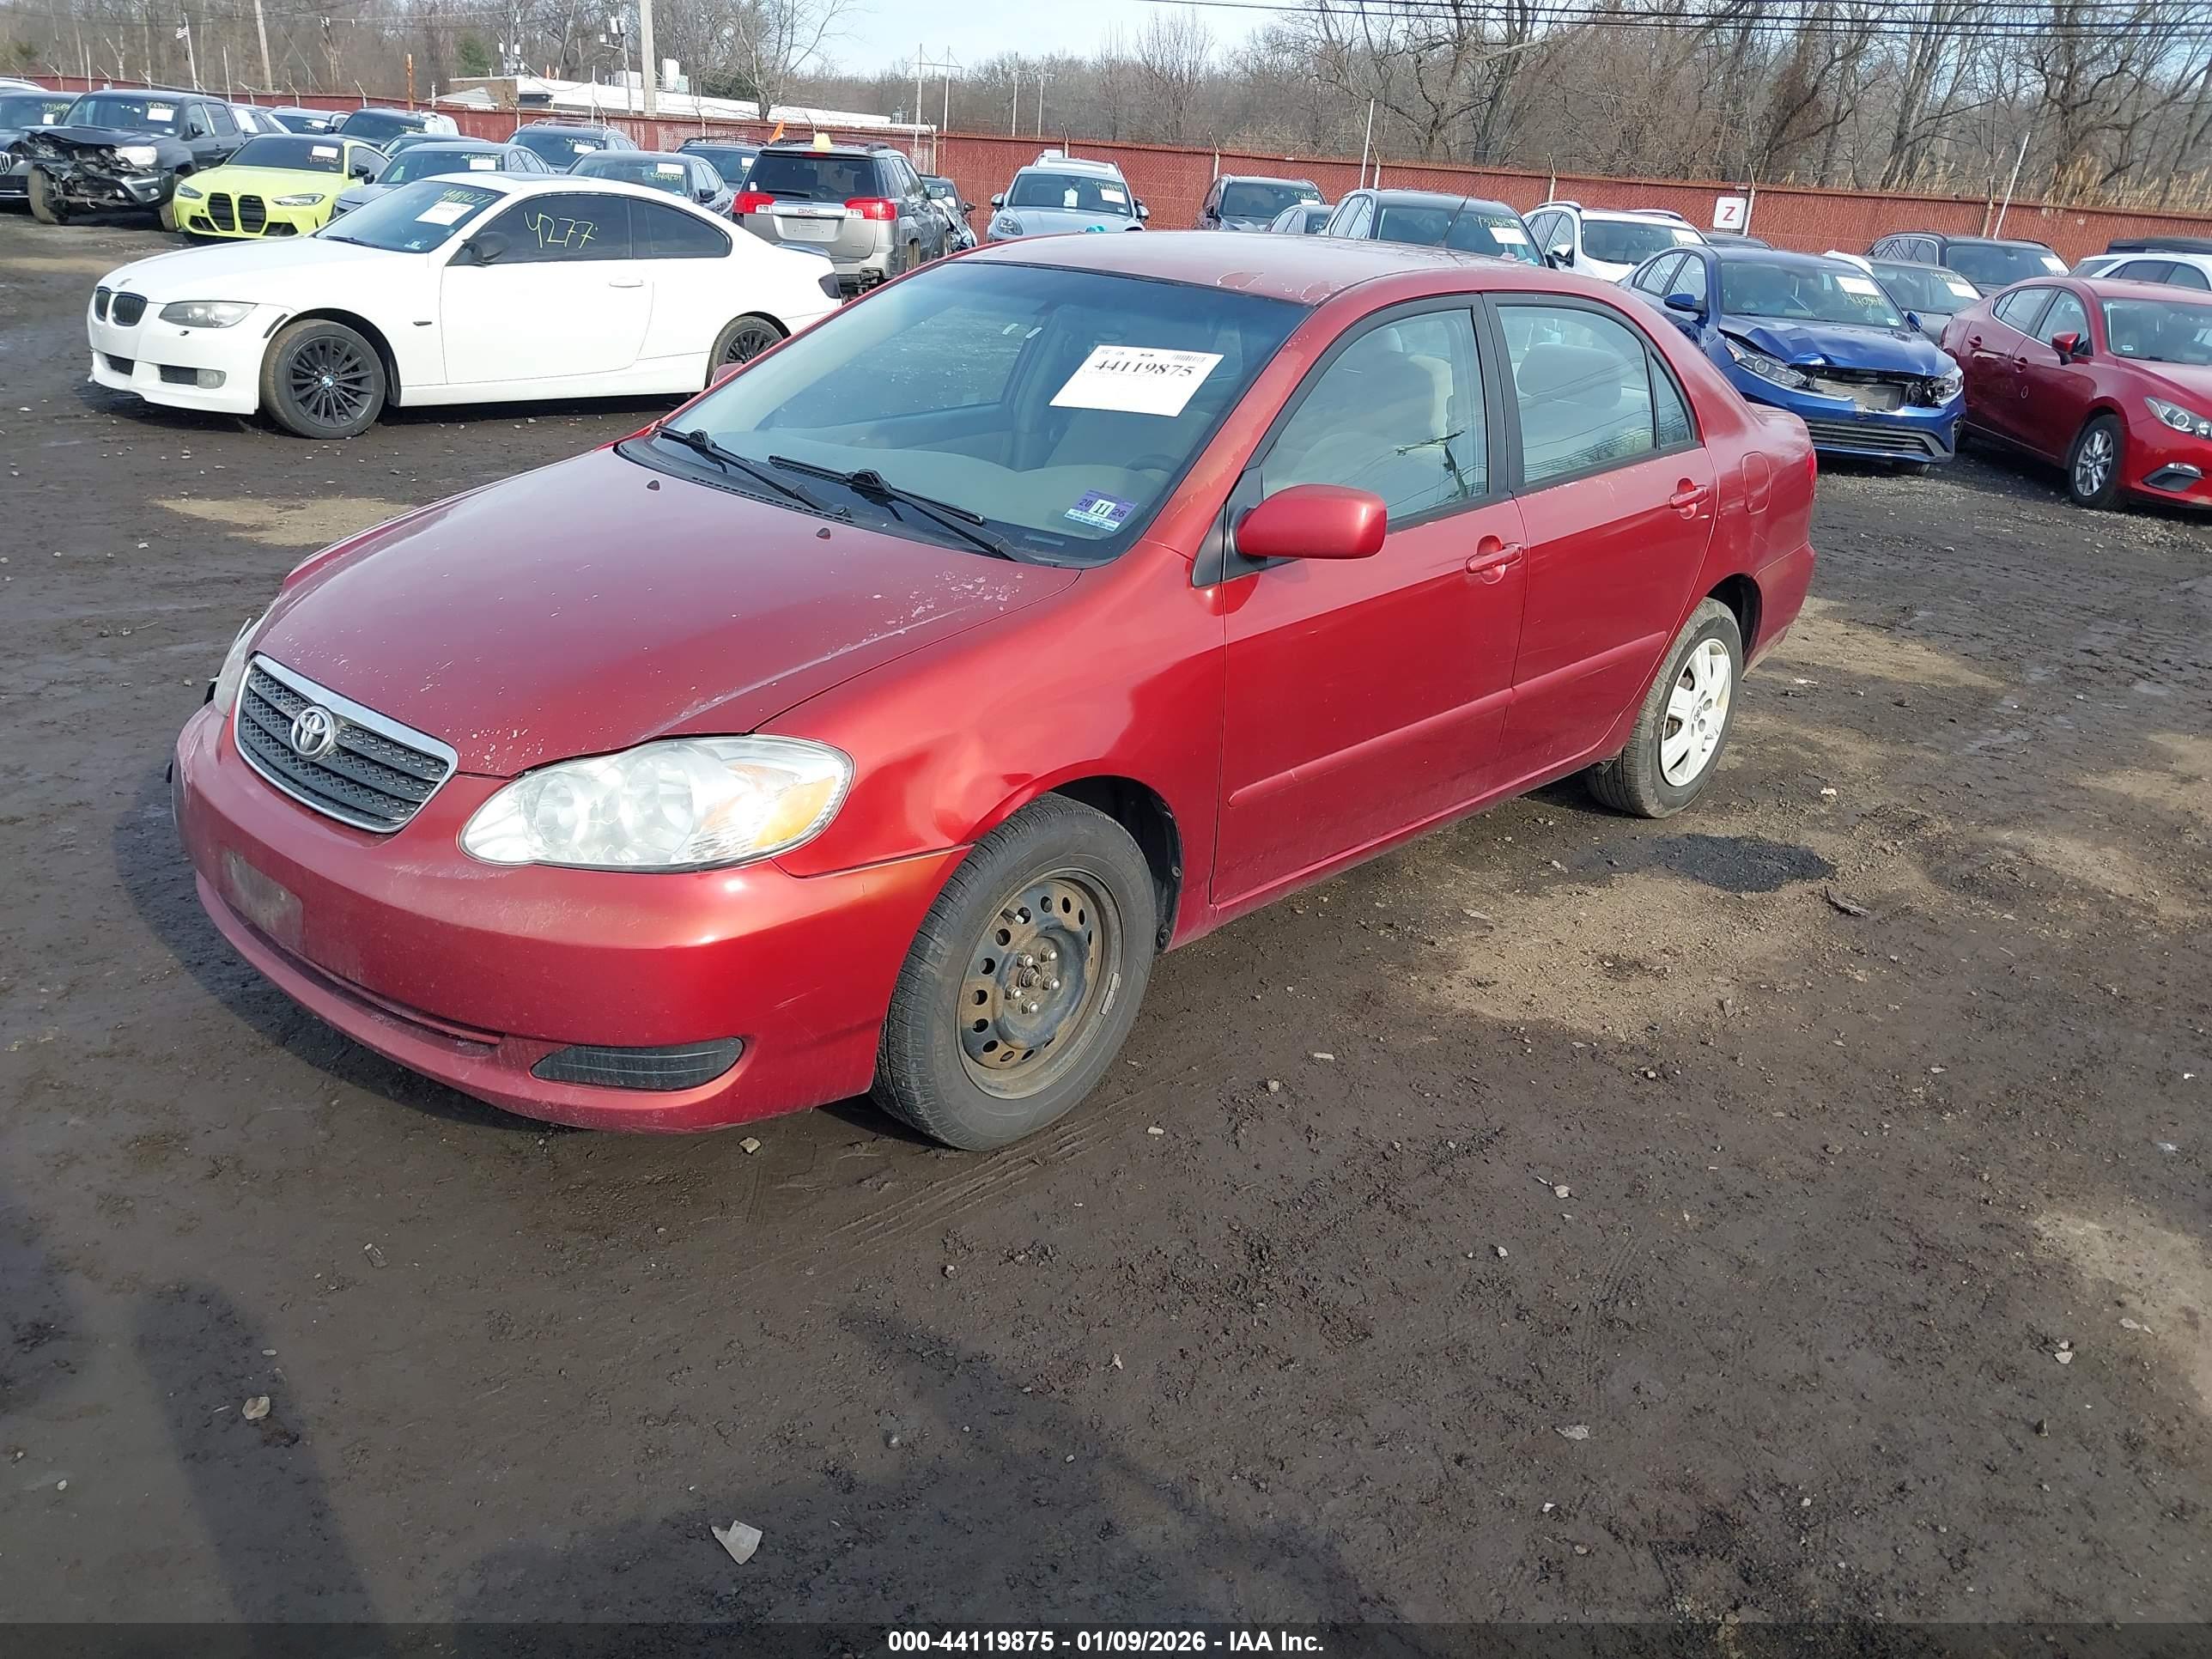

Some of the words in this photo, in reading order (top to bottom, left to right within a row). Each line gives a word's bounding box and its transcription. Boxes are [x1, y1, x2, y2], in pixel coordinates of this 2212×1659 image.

[1723, 206, 1736, 222] Z
[524, 211, 596, 249] 4277
[1094, 359, 1195, 378] 44119875
[1093, 502, 1111, 516] 11
